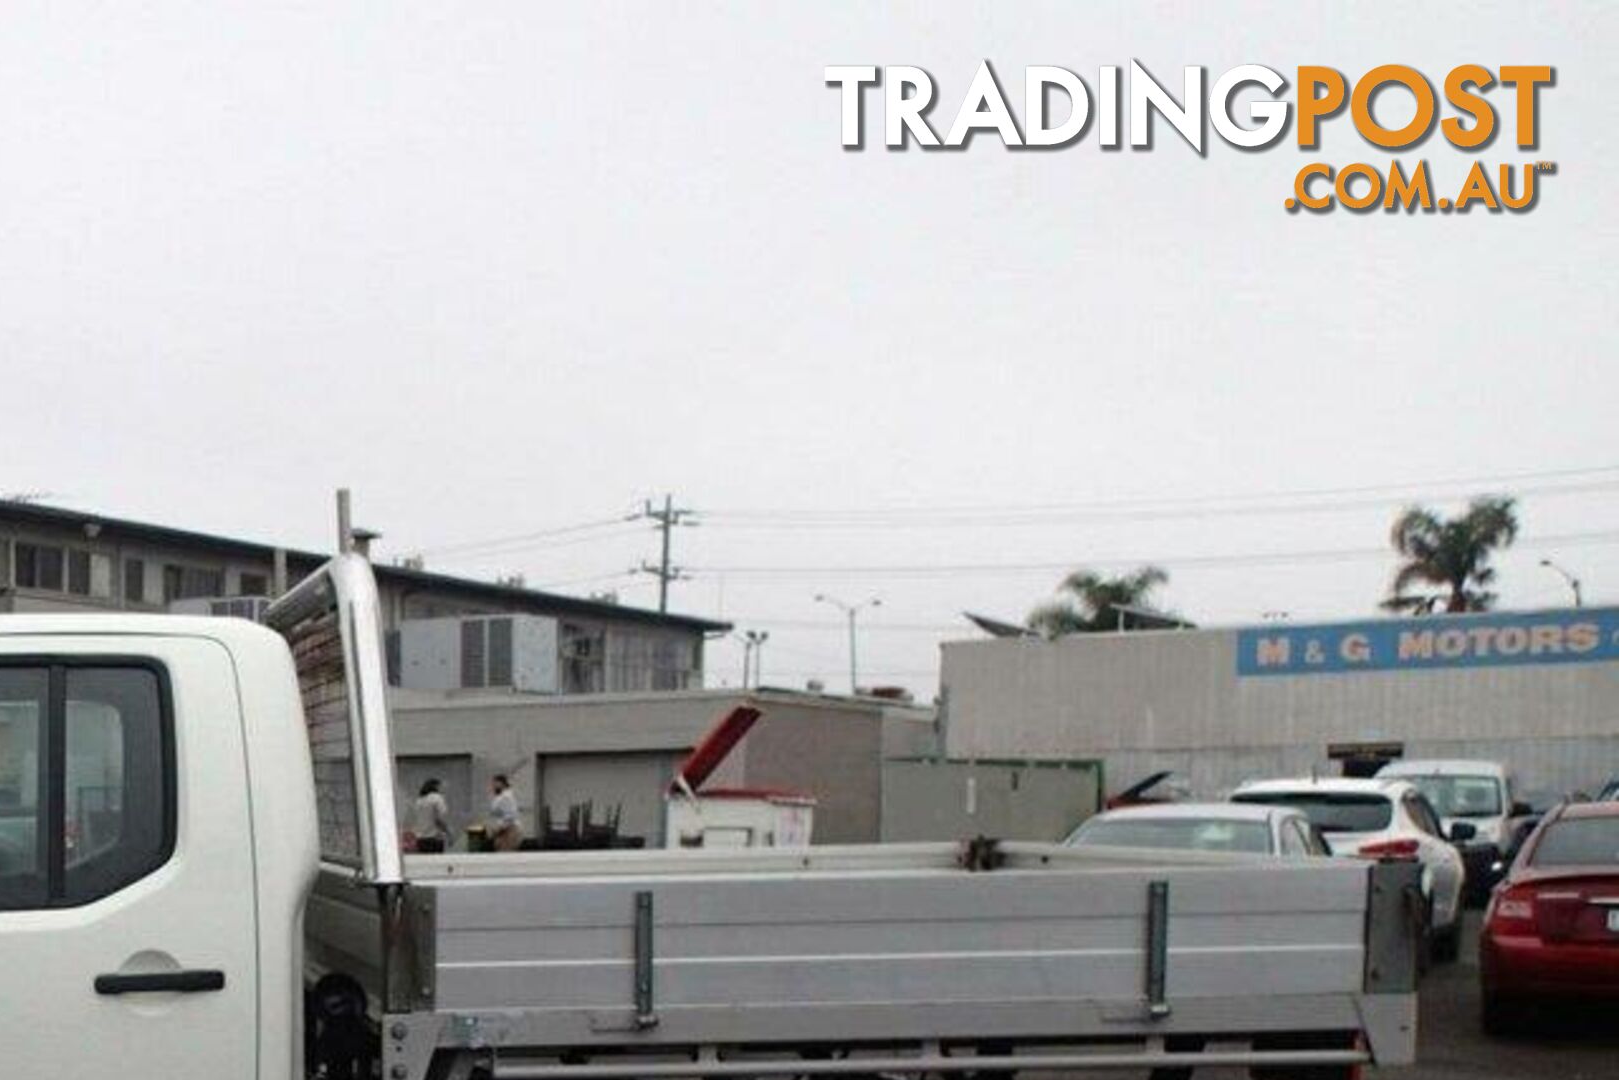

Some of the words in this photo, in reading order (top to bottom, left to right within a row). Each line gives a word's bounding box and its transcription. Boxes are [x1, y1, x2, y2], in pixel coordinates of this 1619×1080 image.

[1256, 637, 1289, 666] M
[1304, 640, 1326, 663] &
[1340, 632, 1371, 661] G
[1398, 623, 1600, 661] MOTORS
